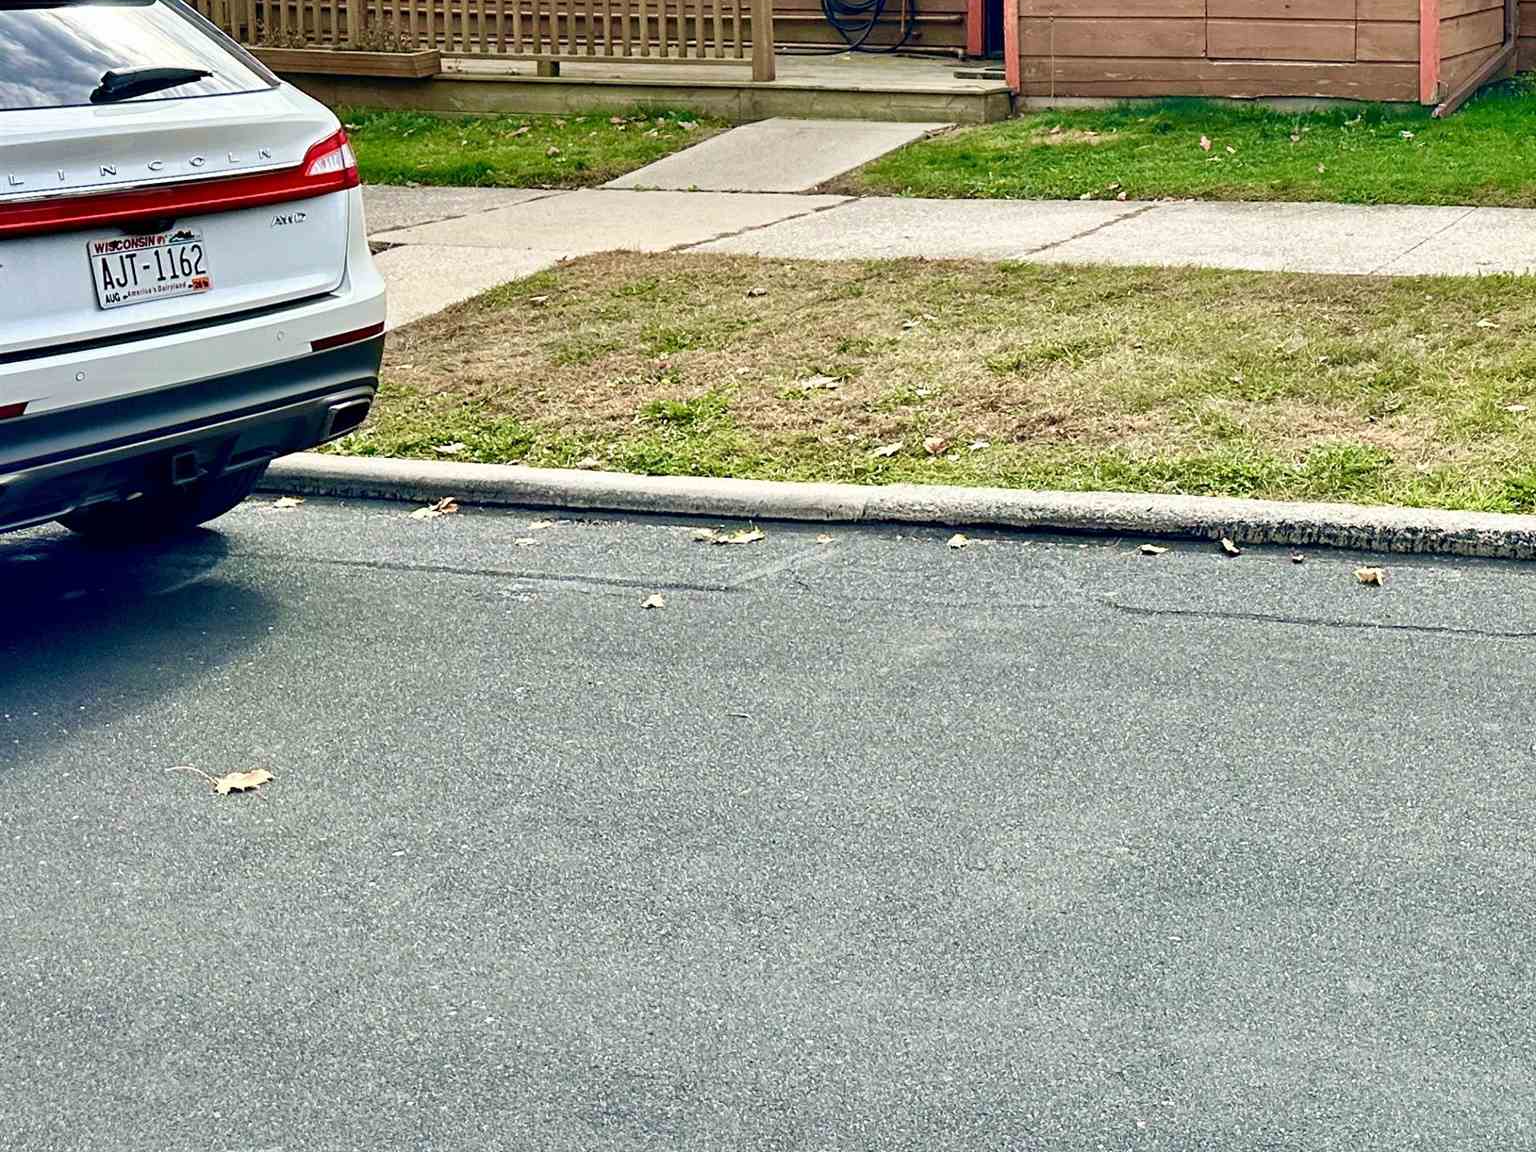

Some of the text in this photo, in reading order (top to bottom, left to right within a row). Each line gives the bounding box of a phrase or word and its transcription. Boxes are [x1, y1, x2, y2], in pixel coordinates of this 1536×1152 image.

[8, 148, 272, 186] LINCOLN
[94, 236, 155, 254] WISCONSIN
[101, 244, 206, 290] AJT-1162
[105, 292, 121, 304] AUG
